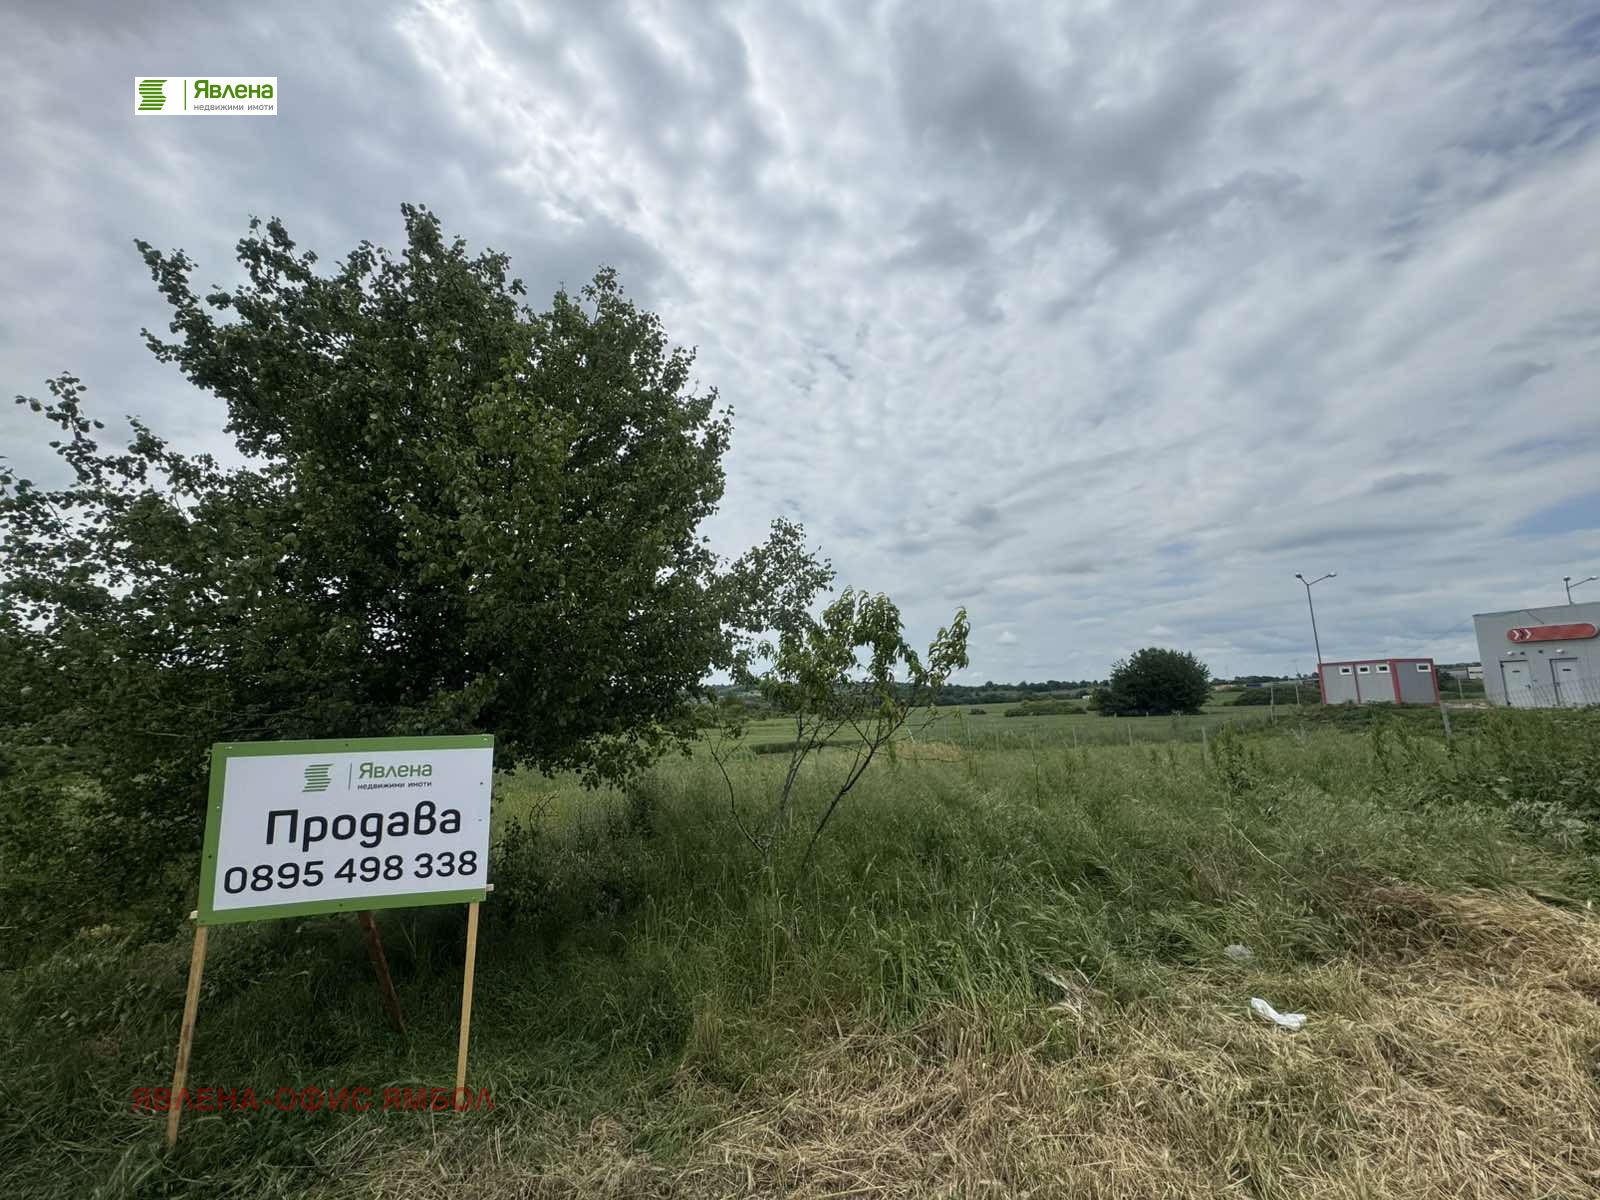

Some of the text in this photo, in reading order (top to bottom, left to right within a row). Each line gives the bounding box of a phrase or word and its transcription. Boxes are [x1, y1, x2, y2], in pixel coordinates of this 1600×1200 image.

[357, 780, 433, 791] недвижими имоти
[358, 762, 433, 780] Явлена
[266, 800, 462, 853] Продава
[223, 850, 478, 895] 0895 498 338
